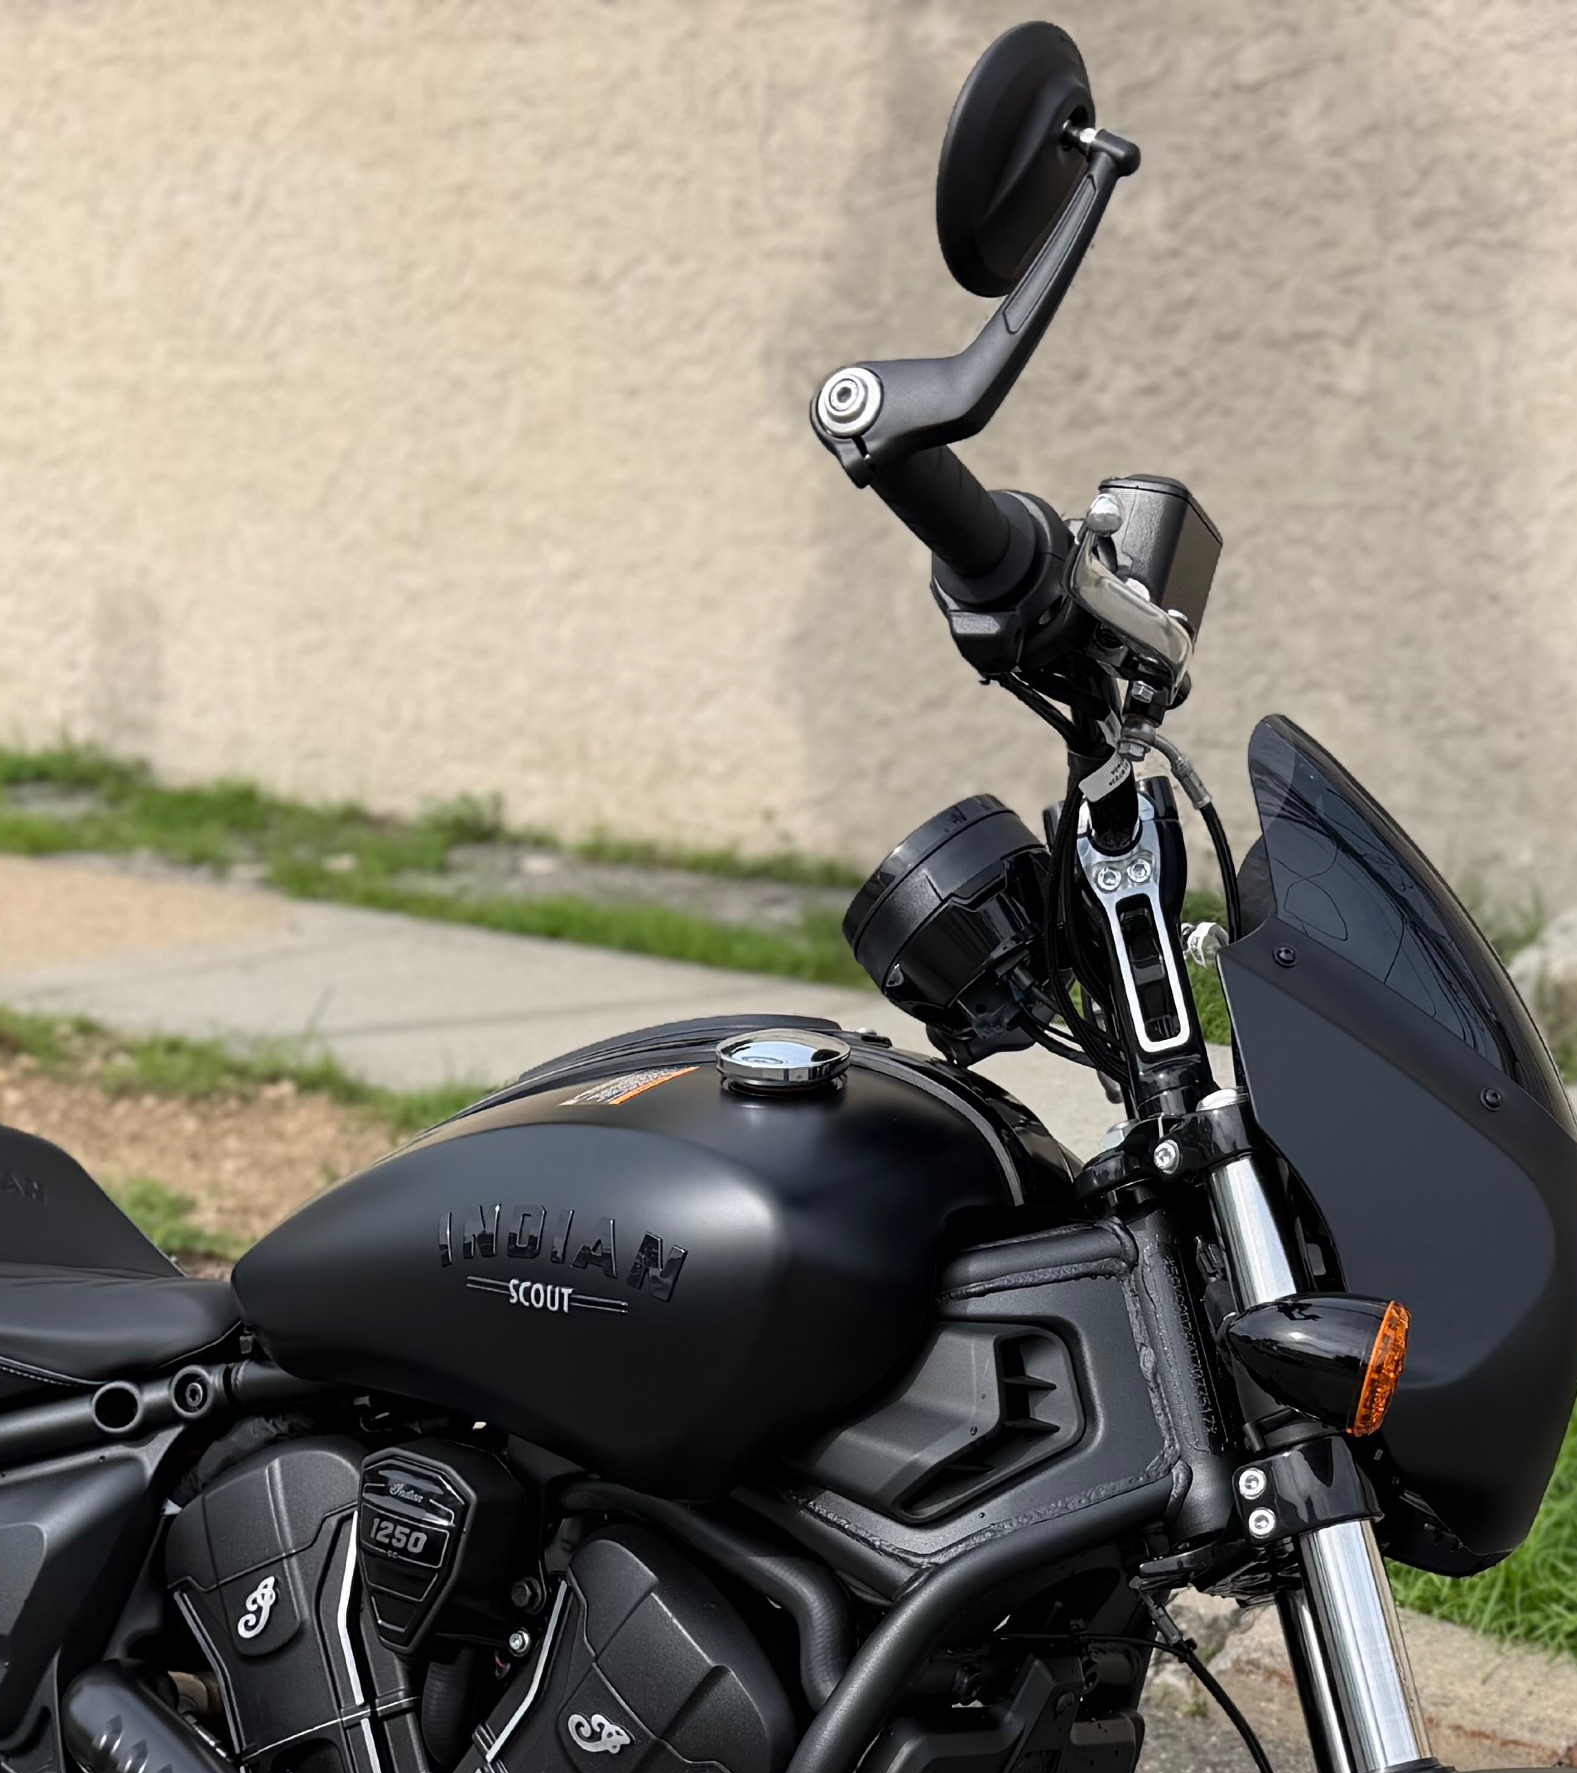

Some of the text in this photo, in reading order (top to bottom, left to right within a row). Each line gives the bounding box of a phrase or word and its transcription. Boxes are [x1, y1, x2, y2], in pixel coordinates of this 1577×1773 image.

[438, 1202, 689, 1303] INDIAN
[508, 1278, 575, 1314] SCOUT
[389, 1483, 424, 1503] Indian
[370, 1518, 428, 1554] 1250
